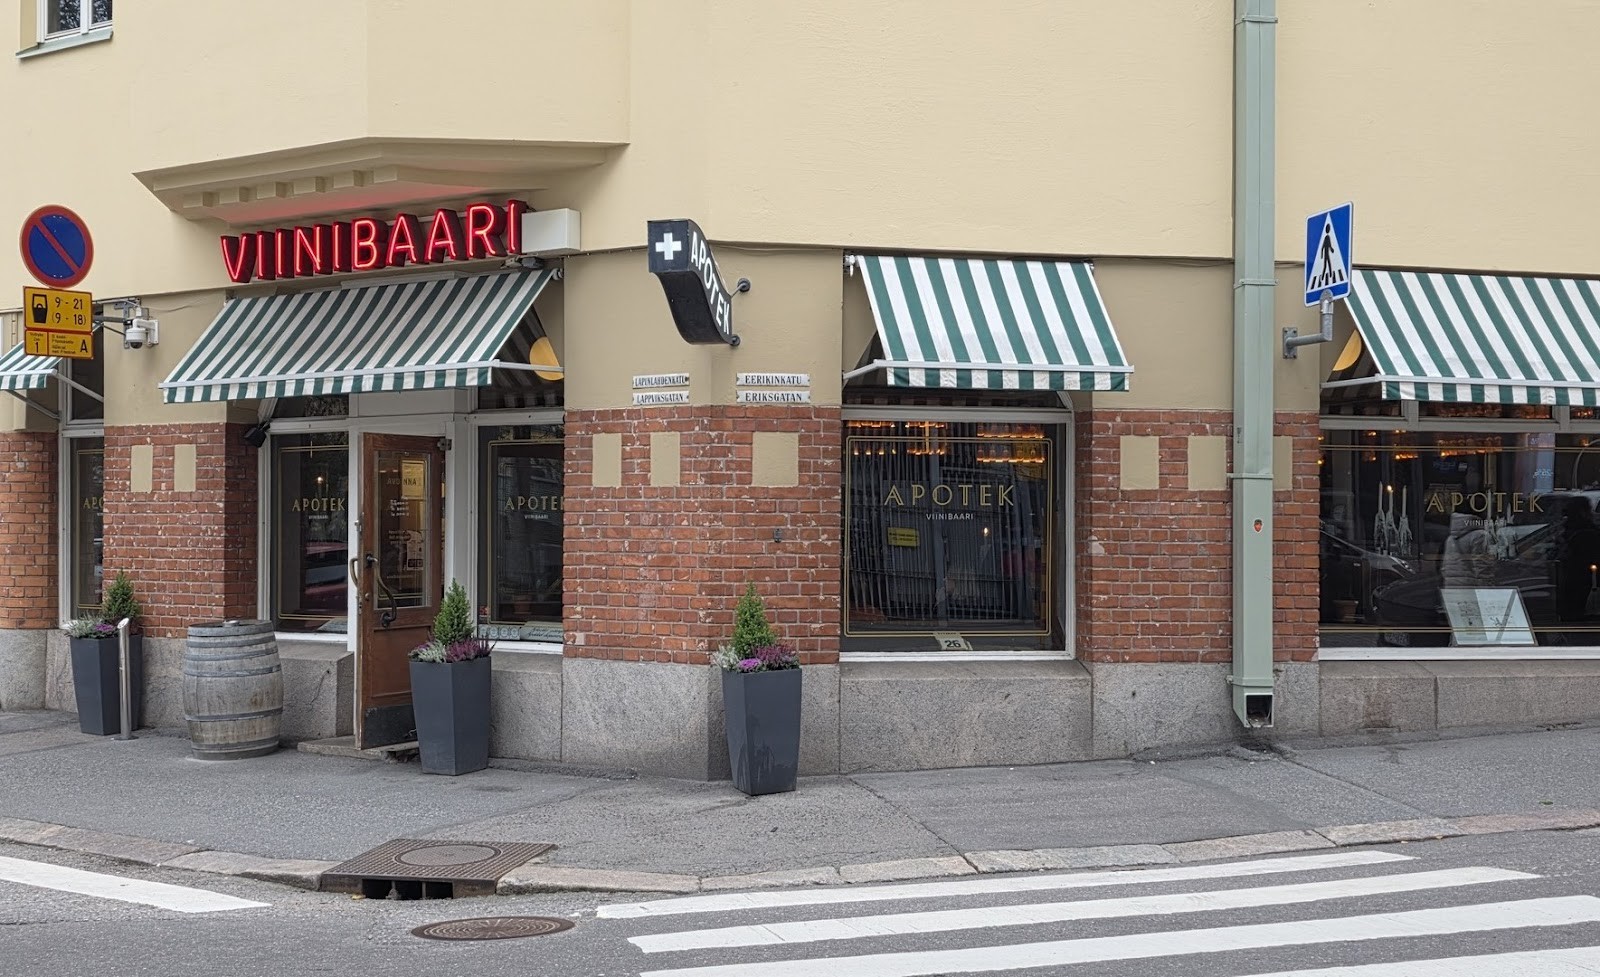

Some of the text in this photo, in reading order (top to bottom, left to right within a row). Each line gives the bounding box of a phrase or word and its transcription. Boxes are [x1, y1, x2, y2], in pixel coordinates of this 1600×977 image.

[221, 200, 526, 283] VIINIBAARI
[690, 231, 730, 335] APOTEK
[55, 296, 61, 308] 9
[73, 298, 83, 310] 21
[73, 313, 86, 326] 18)
[80, 339, 89, 353] A
[745, 375, 802, 385] EERIKINKATU
[745, 392, 802, 402] ERIKSGATAN
[884, 484, 1015, 506] APOTEK
[1426, 492, 1544, 512] APOTEK
[292, 498, 345, 511] APOTEK
[944, 639, 961, 648] 26
